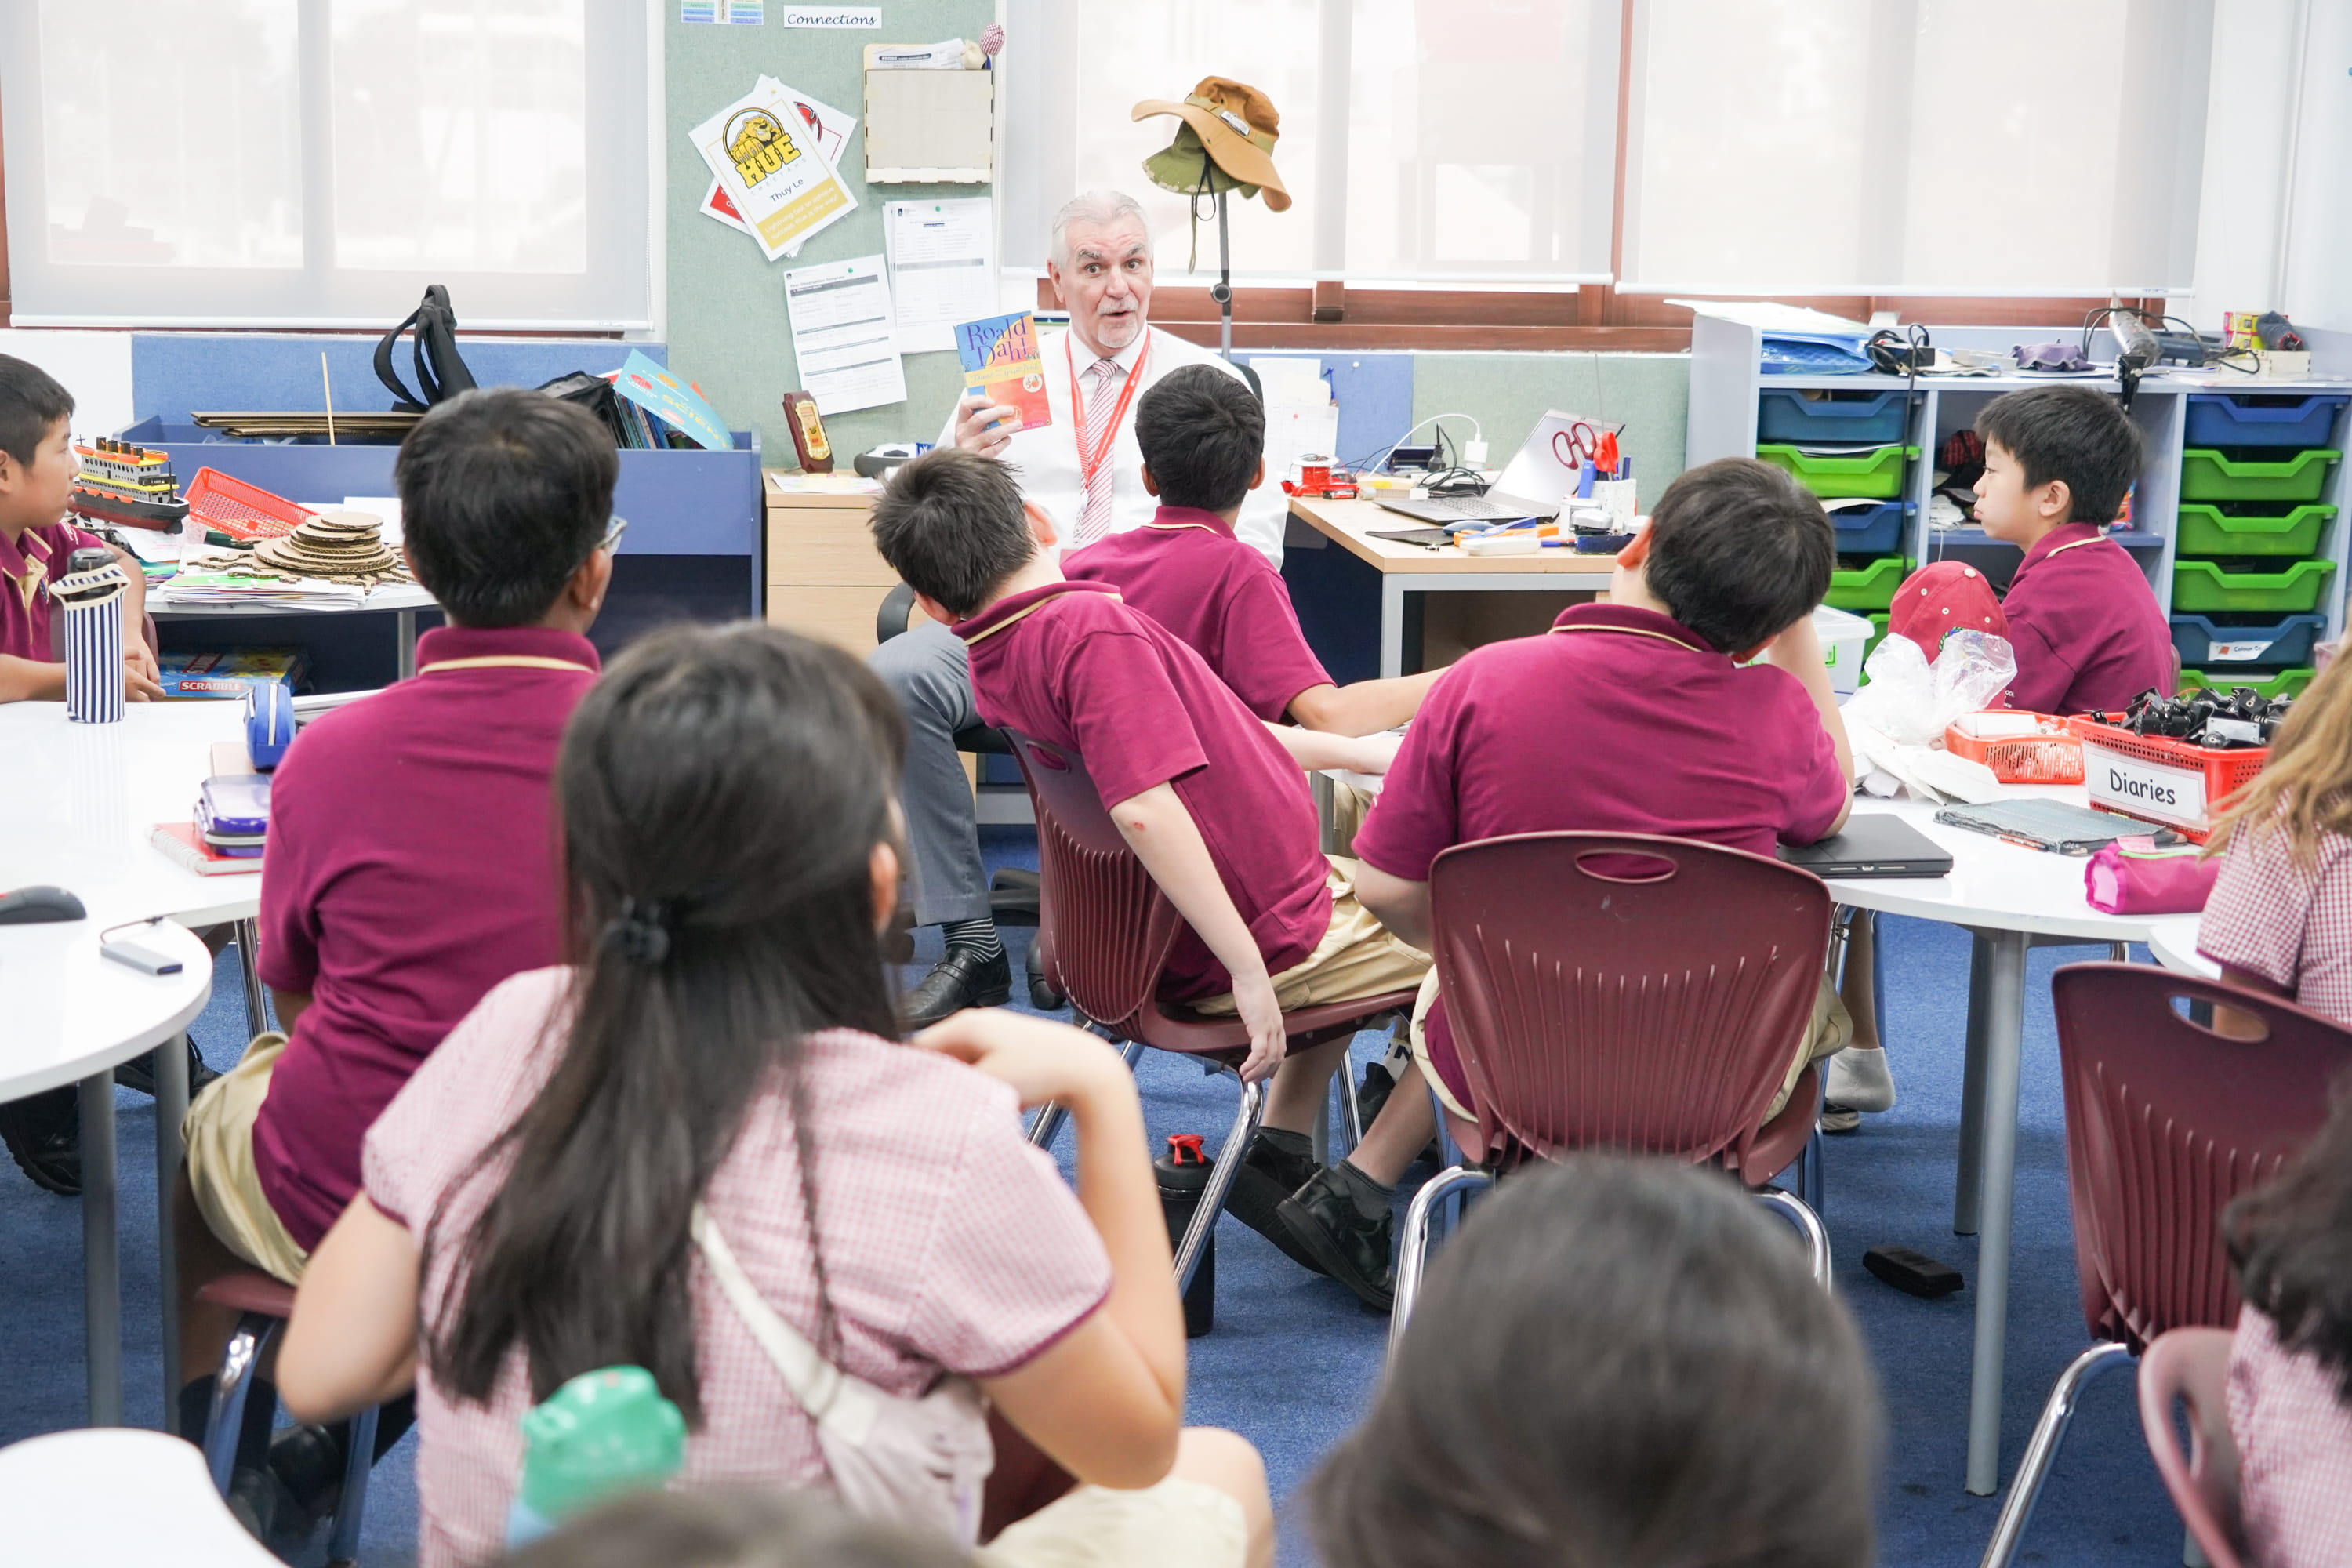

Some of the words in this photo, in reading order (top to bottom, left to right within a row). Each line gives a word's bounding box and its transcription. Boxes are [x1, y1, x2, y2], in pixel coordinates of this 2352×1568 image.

[787, 13, 877, 25] Connections
[734, 132, 802, 189] HUE
[770, 186, 792, 201] Thuy
[792, 179, 804, 188] Le
[967, 315, 1027, 351] Roald
[978, 338, 1027, 367] Dahl
[181, 681, 242, 691] SCRABBLE
[2110, 768, 2176, 805] Diaries
